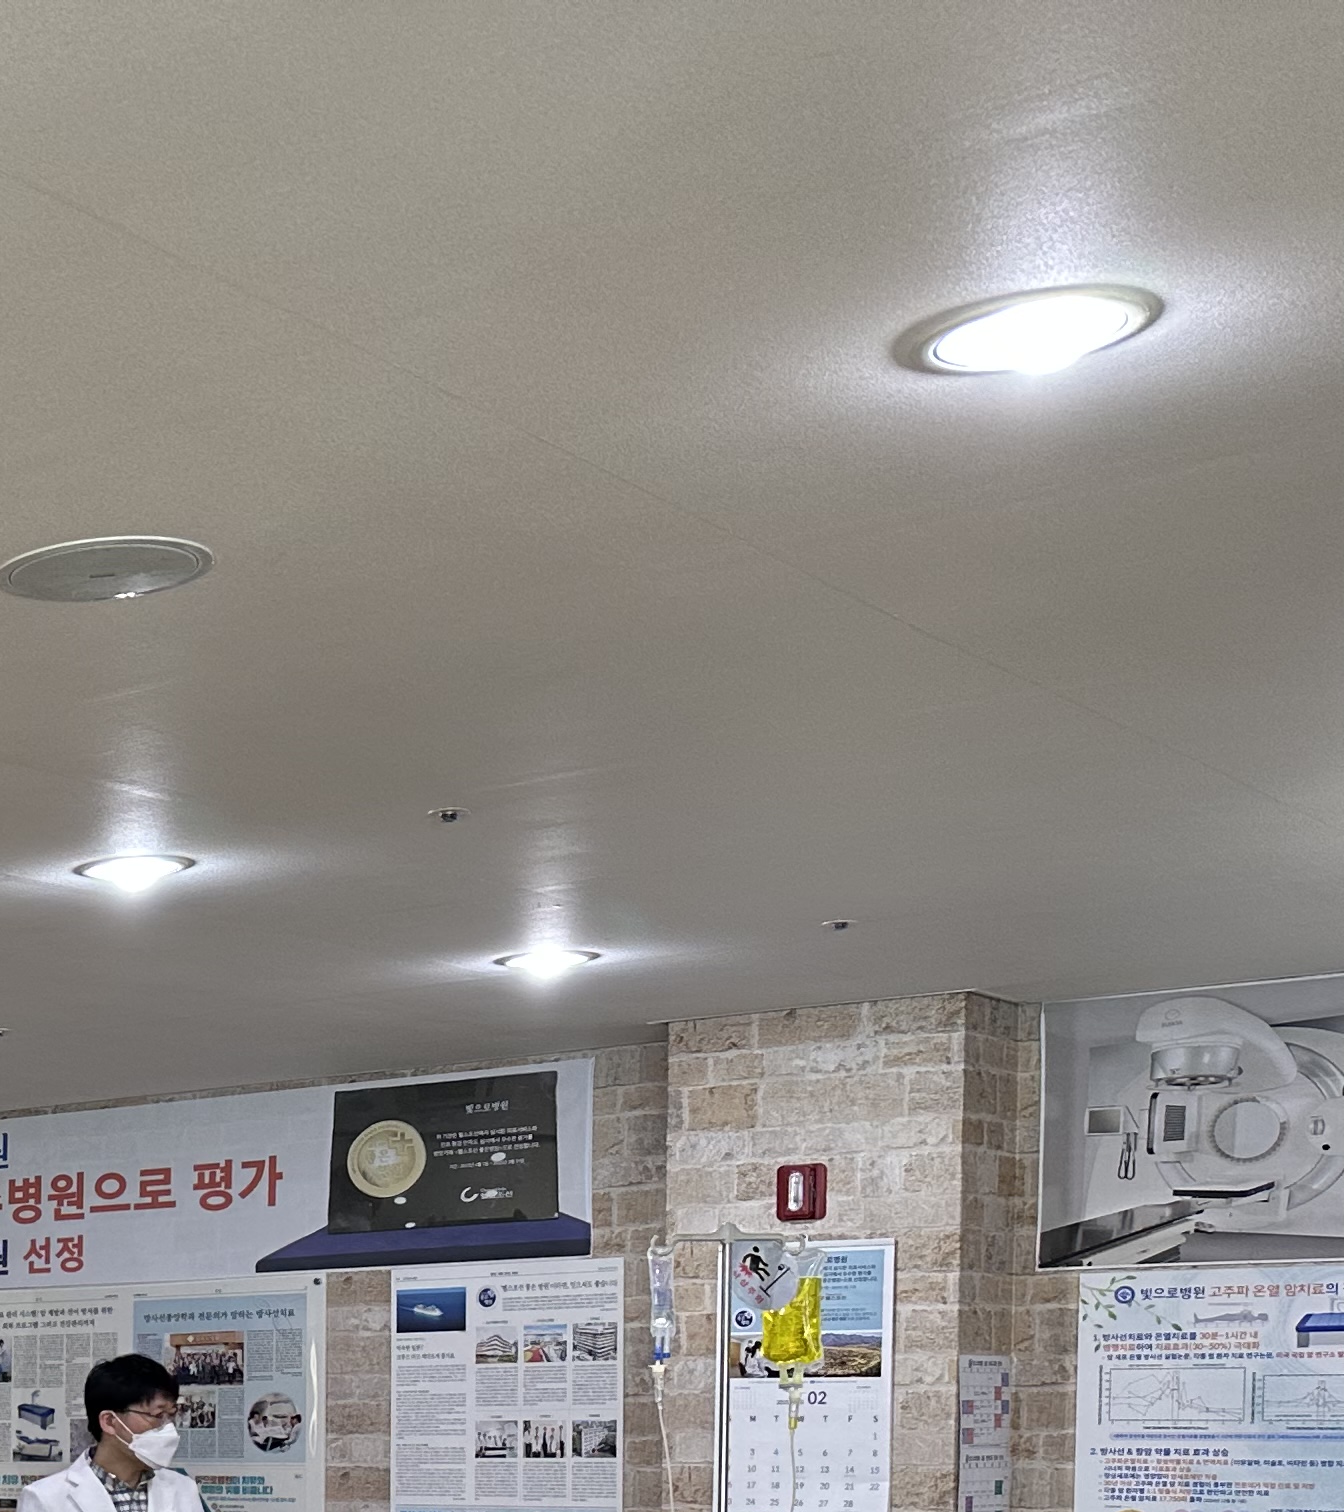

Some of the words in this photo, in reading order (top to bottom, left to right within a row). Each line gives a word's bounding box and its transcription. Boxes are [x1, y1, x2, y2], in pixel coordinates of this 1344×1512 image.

[192, 1155, 284, 1211] 평가
[22, 1234, 85, 1275] 선정
[1141, 1286, 1205, 1301] 빛으로병원
[1210, 1285, 1250, 1298] 고주파
[1253, 1284, 1280, 1297] 온열
[1284, 1282, 1339, 1297] 암치료의
[807, 1391, 828, 1406] 02
